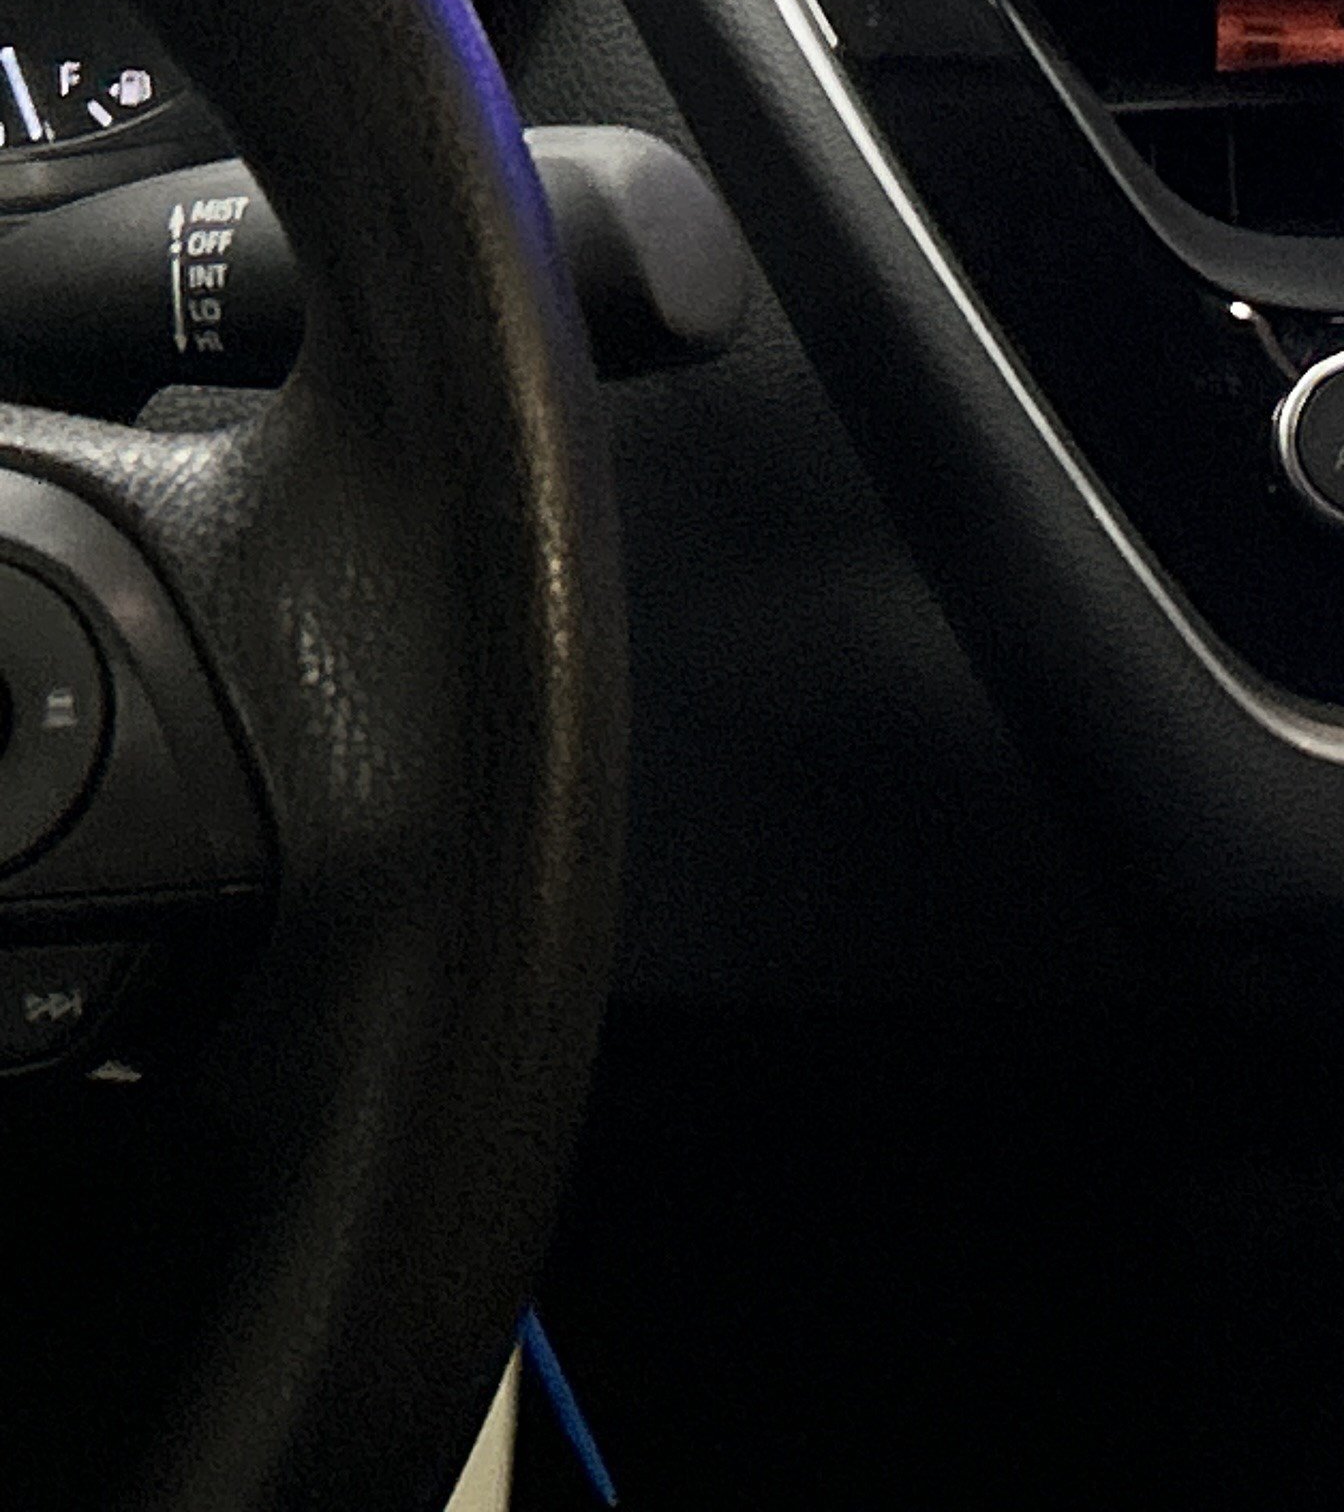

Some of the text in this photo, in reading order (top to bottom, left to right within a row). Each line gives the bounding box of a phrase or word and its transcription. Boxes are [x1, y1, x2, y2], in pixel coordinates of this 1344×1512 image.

[59, 60, 82, 98] F
[187, 229, 235, 257] OFF
[188, 263, 229, 289] INT
